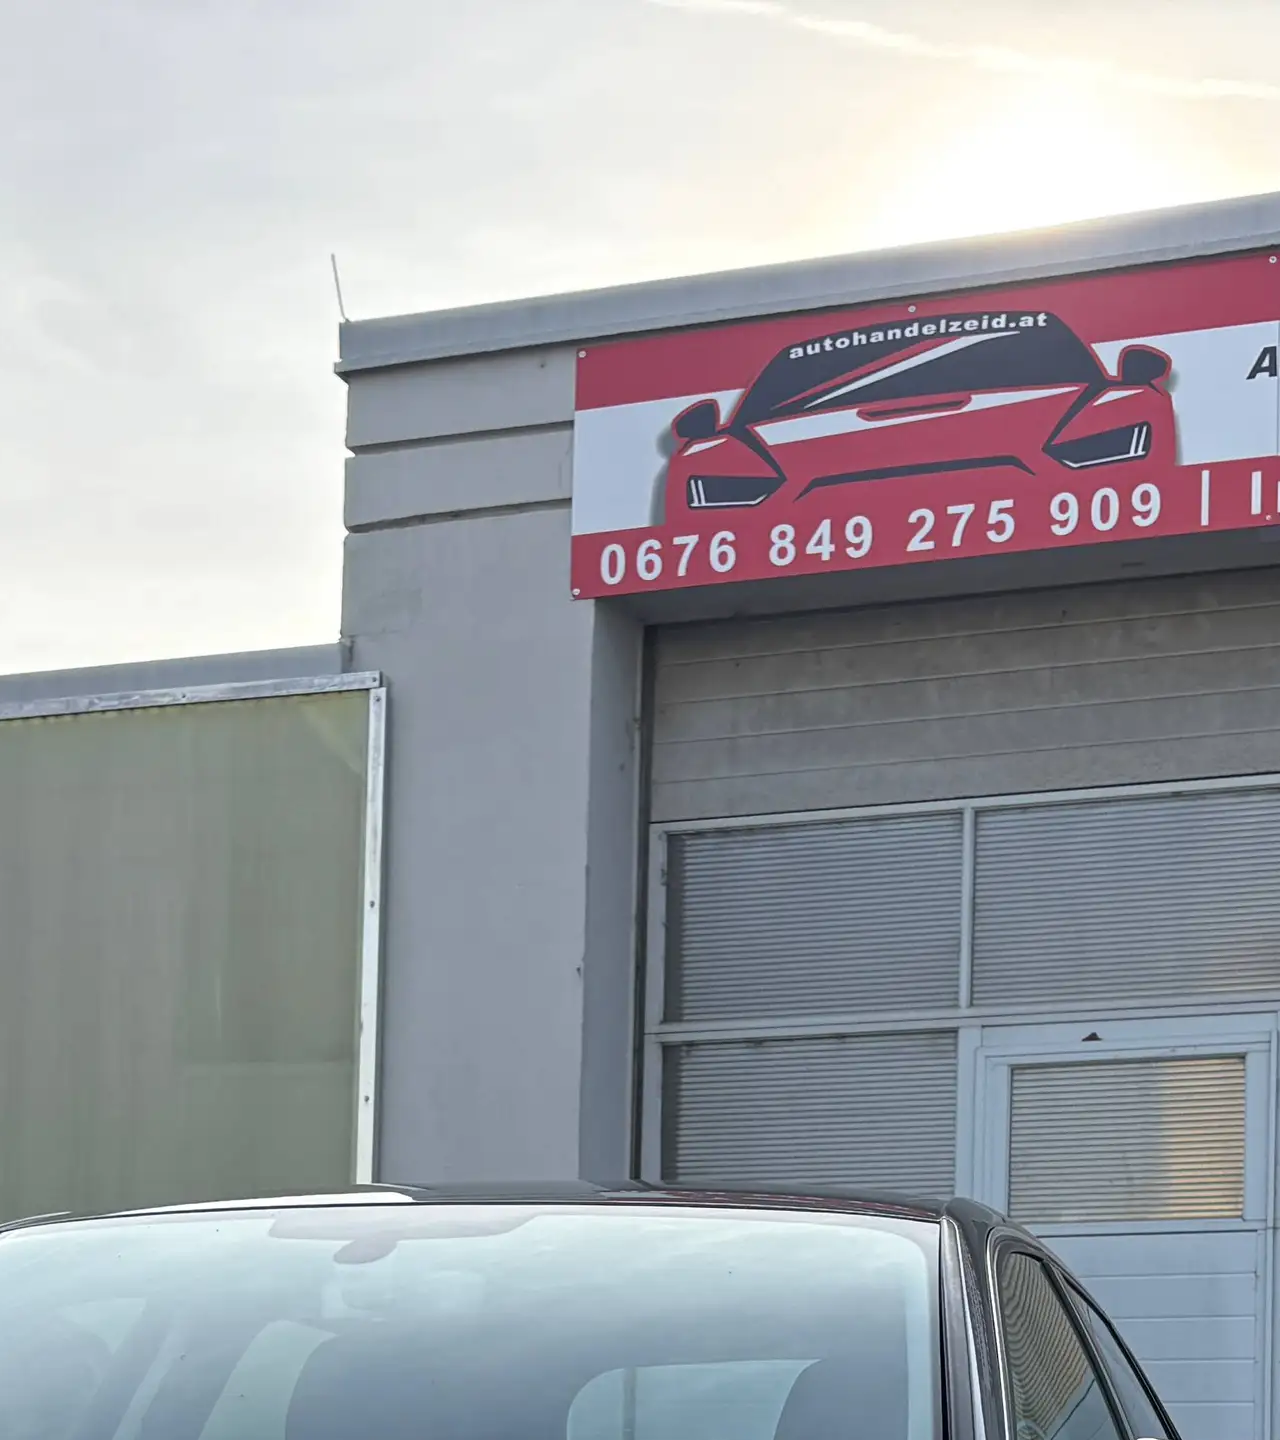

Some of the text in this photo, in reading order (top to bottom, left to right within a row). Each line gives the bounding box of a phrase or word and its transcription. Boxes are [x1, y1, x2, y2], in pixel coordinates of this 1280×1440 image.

[789, 312, 1048, 360] autohandelzeid.at
[600, 530, 737, 585] 0676
[769, 515, 873, 566] 849
[906, 499, 1015, 552] 275
[1049, 483, 1161, 536] 909
